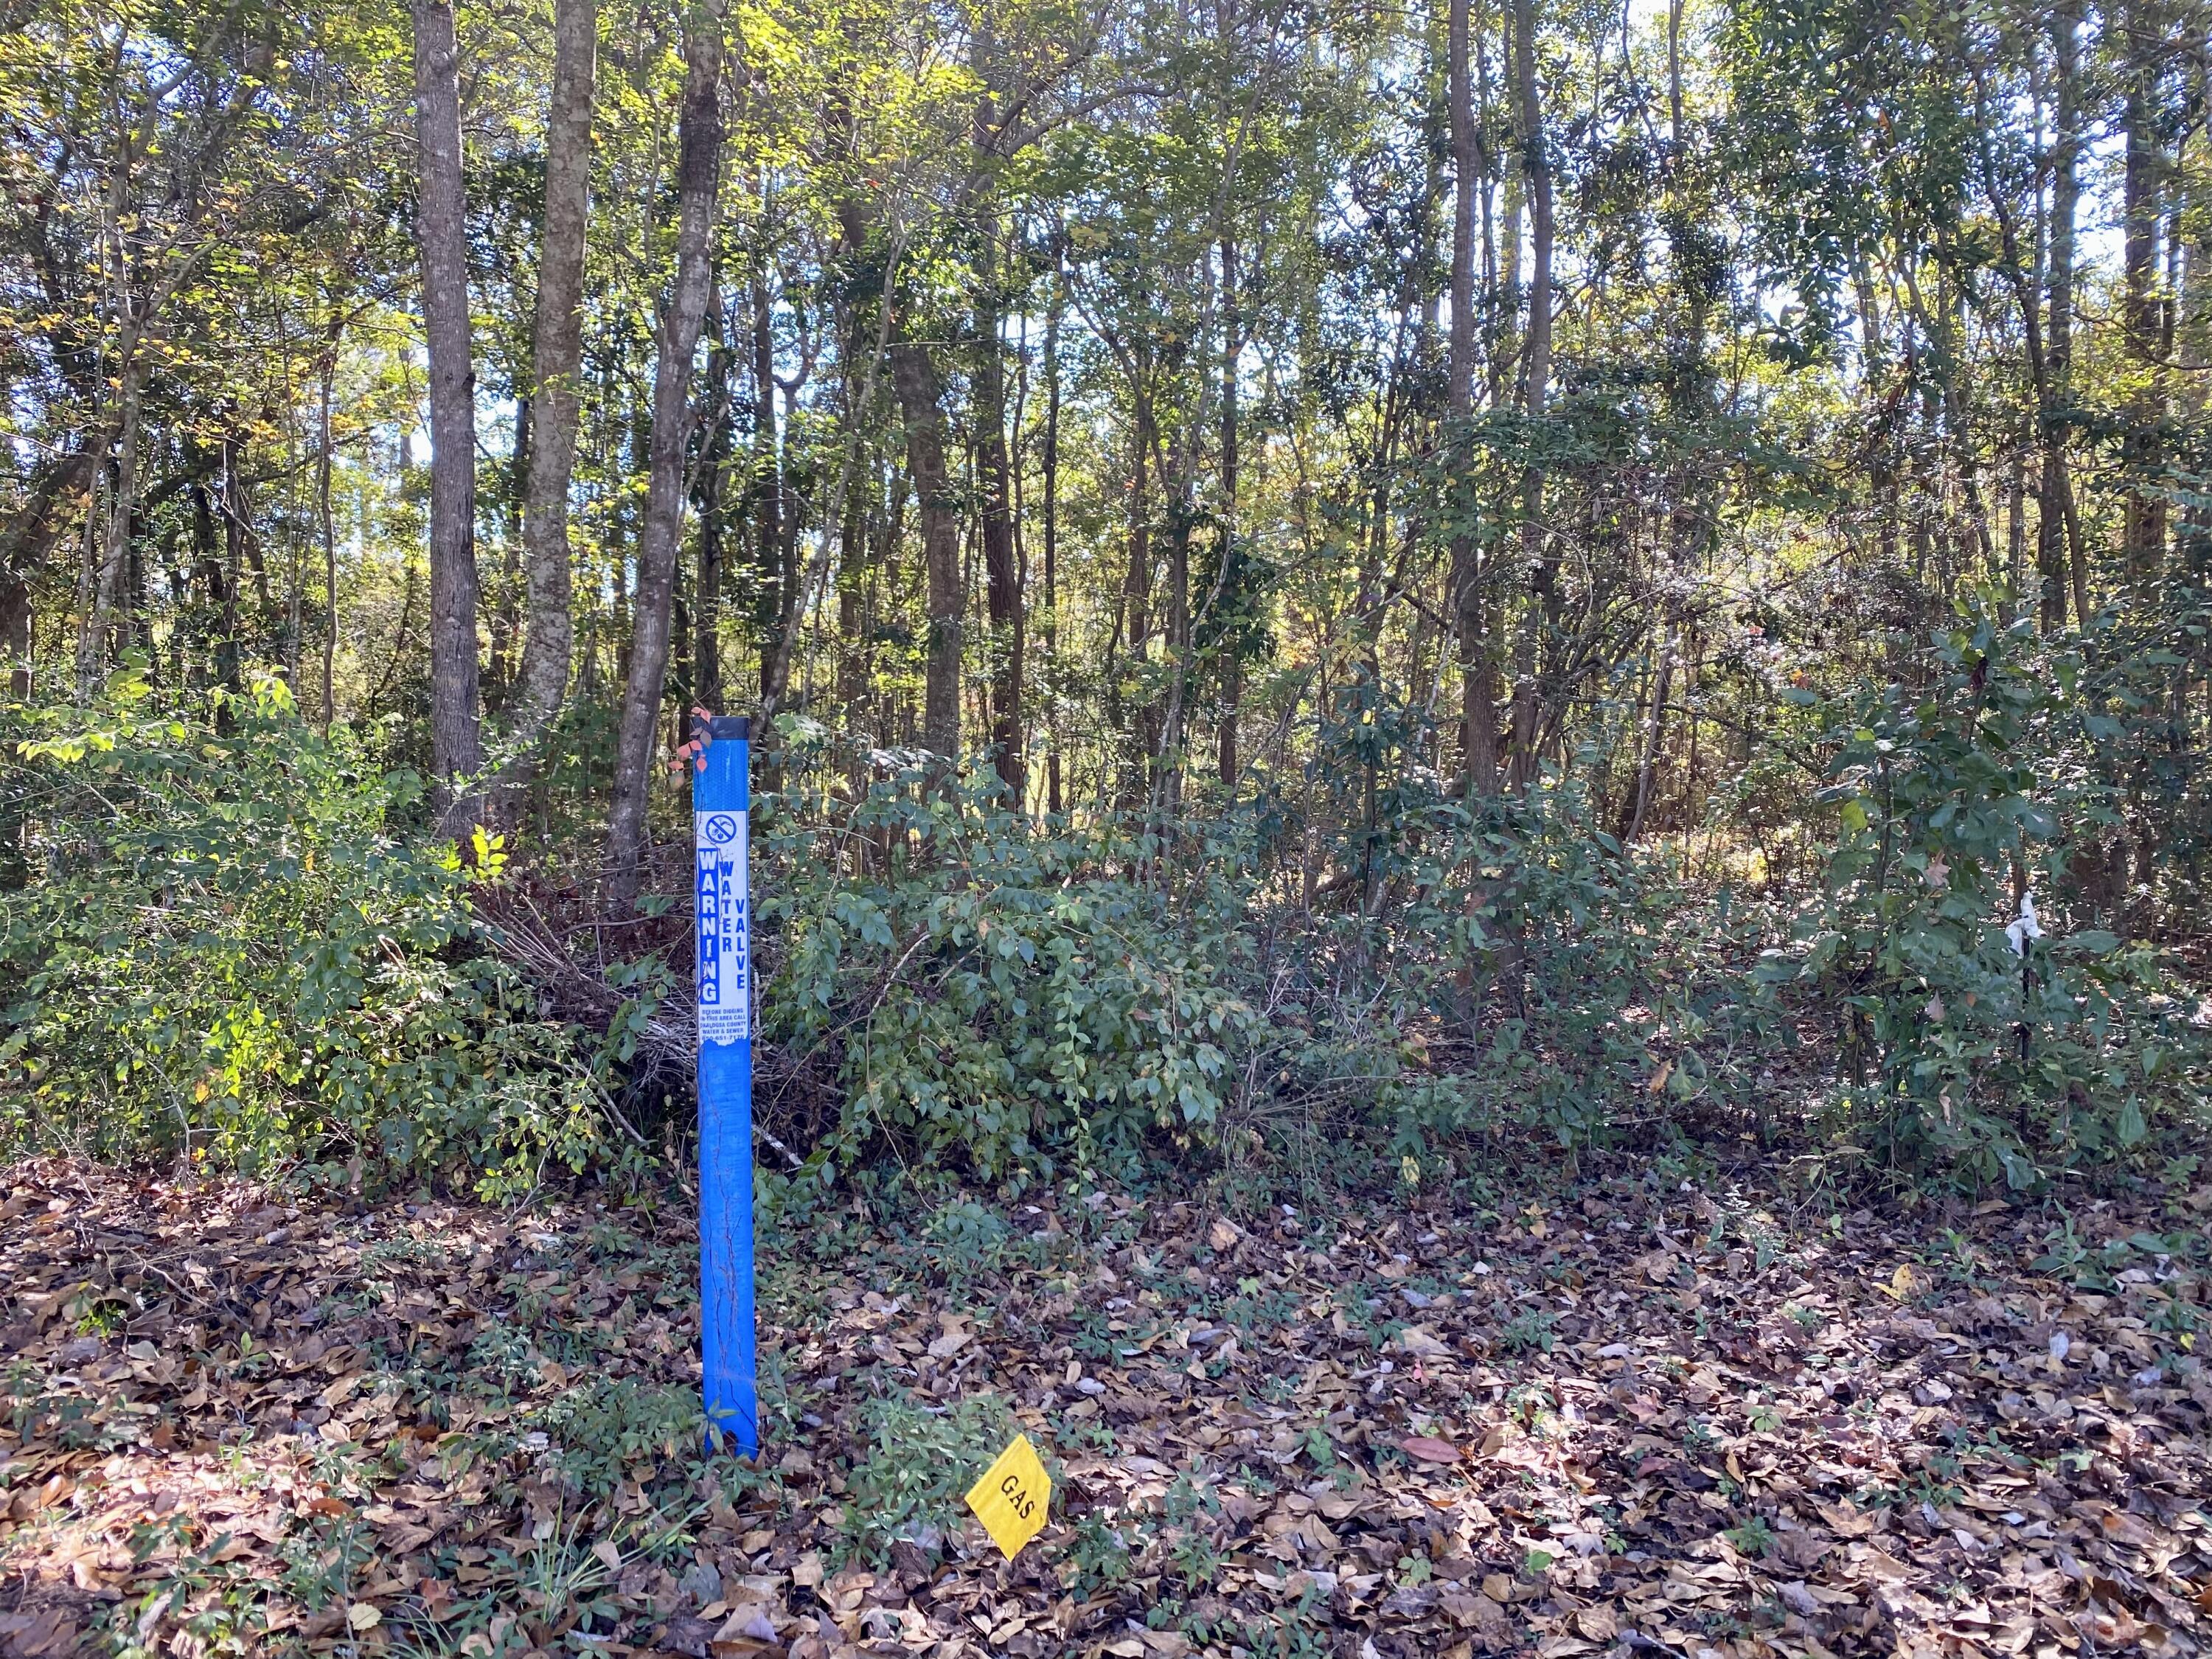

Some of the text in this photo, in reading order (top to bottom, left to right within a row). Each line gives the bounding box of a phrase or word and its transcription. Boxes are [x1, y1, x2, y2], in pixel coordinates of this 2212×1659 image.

[698, 850, 717, 1003] WARNING
[719, 860, 734, 953] WATER
[735, 899, 745, 989] VALVE
[1001, 1475, 1035, 1520] GAS
